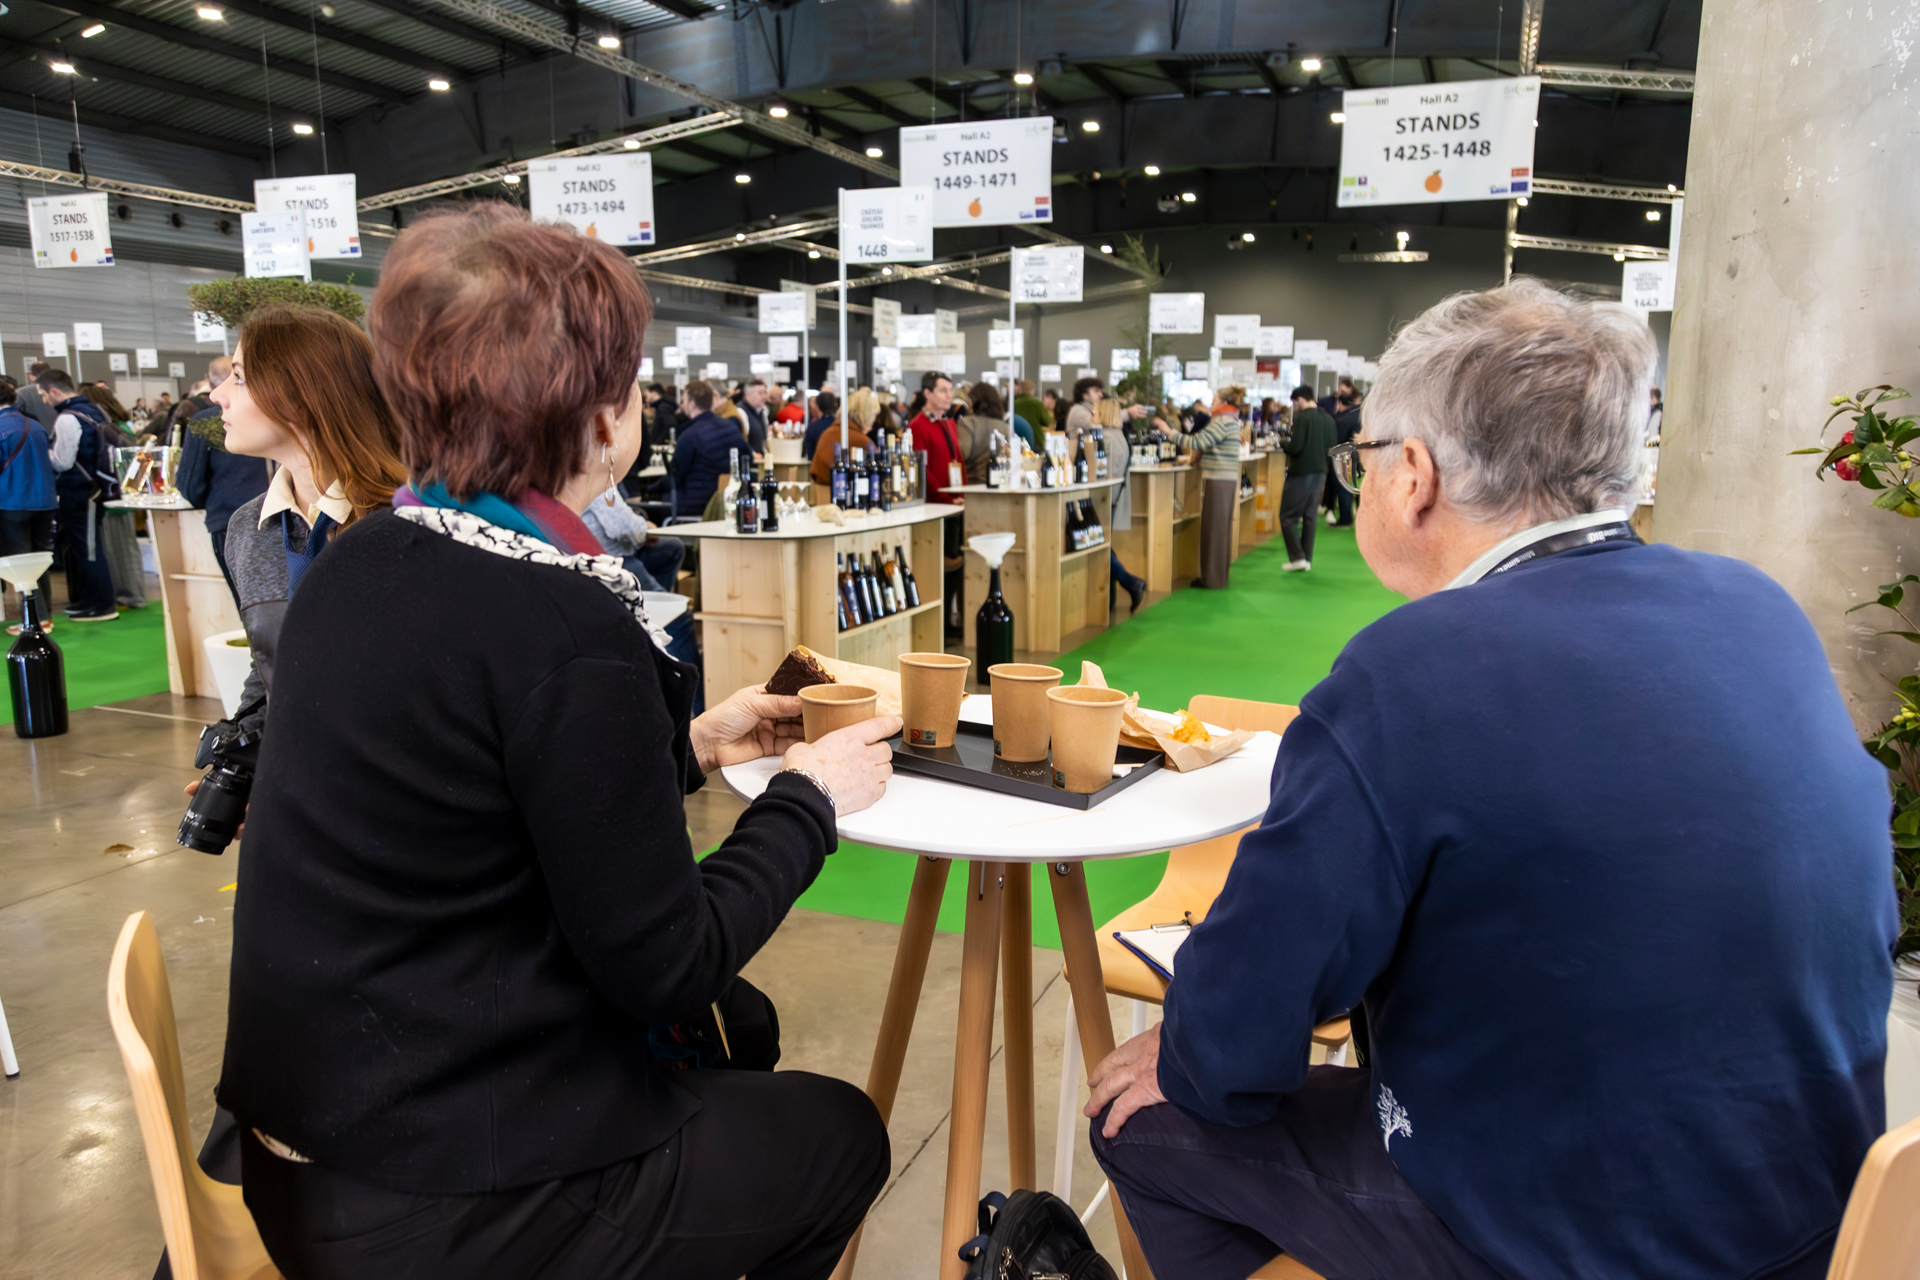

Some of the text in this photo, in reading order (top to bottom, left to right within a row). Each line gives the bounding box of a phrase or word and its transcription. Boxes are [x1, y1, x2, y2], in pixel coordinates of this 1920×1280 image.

[1420, 94, 1460, 106] Hall A2
[1396, 112, 1481, 134] STANDS
[961, 131, 992, 141] Hall A2
[943, 148, 1009, 166] STANDS
[1384, 140, 1492, 162] 1425-1448
[562, 179, 616, 194] STANDS
[934, 172, 1017, 190] 1449-1471
[285, 198, 329, 210] STANDS
[557, 200, 625, 215] 1473-1494
[53, 213, 88, 225] STANDS
[306, 217, 337, 229] -1516
[50, 230, 95, 242] 1517-1538
[858, 244, 888, 258] 1448
[256, 261, 276, 272] 1449
